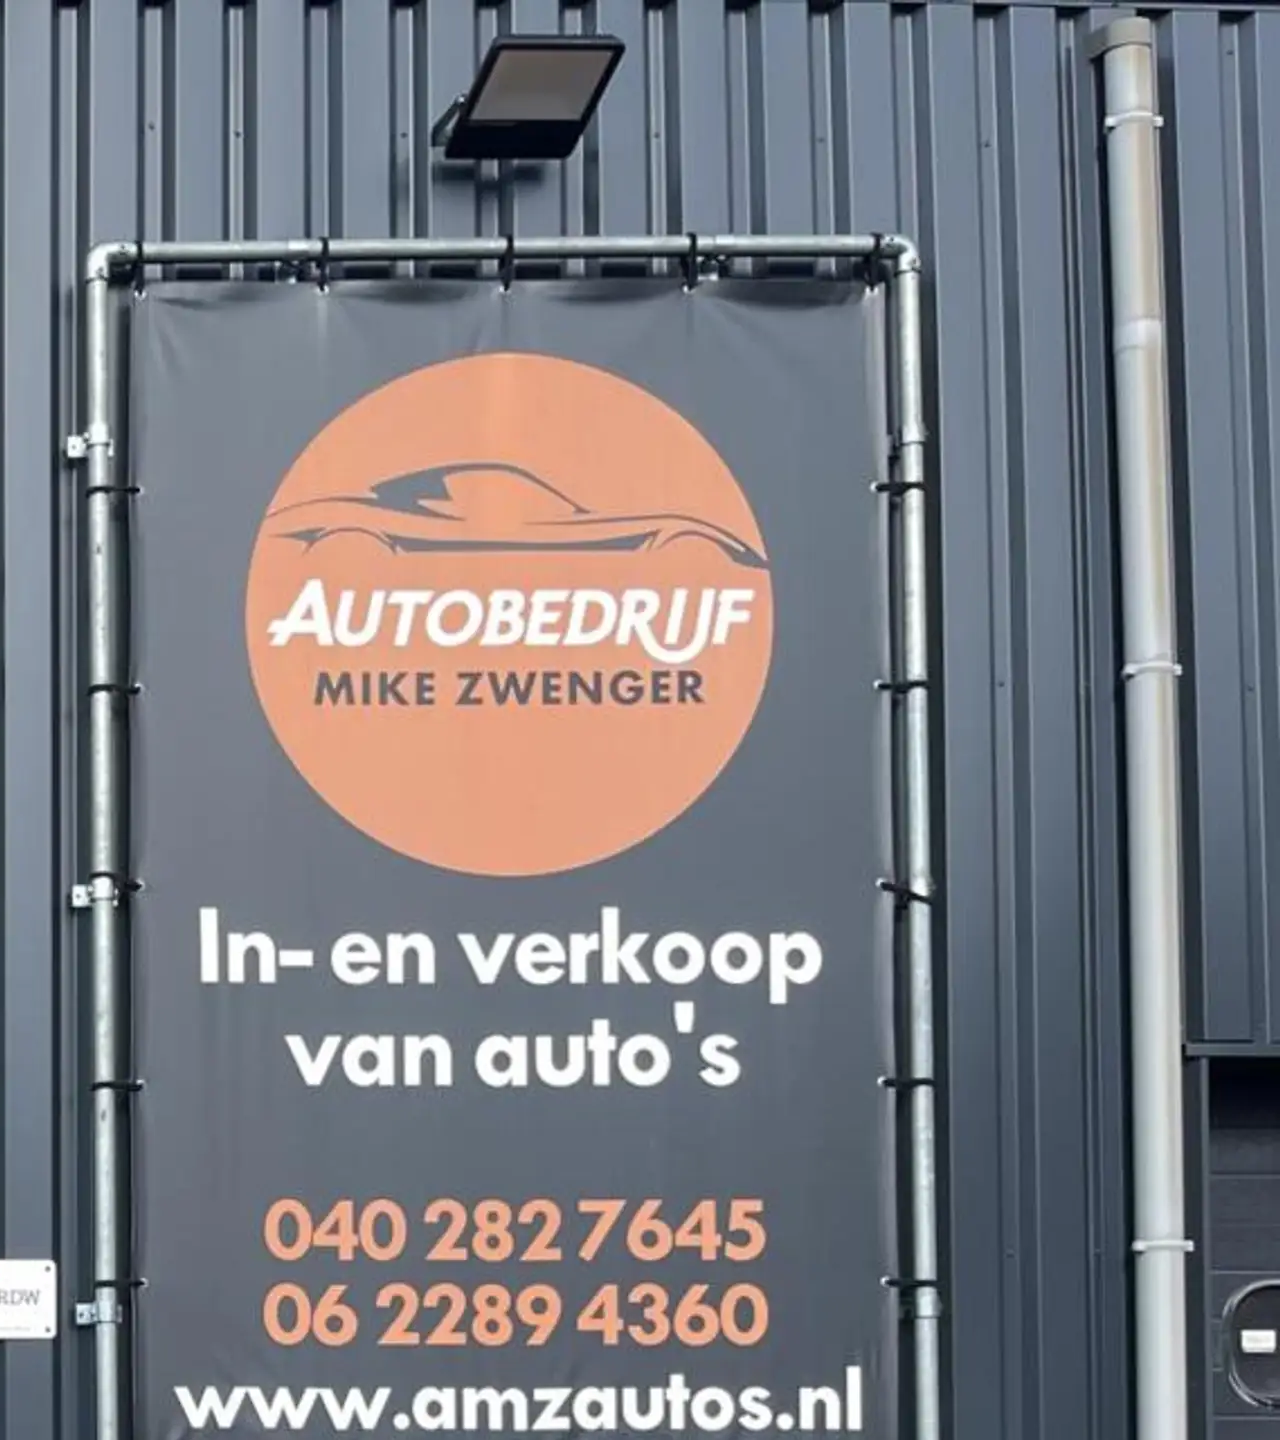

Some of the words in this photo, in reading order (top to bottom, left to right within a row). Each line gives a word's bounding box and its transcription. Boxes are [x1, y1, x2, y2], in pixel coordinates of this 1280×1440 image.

[267, 578, 756, 663] AUTOBEDRIJF
[314, 672, 436, 706] MIKE
[456, 670, 705, 706] ZWENGER
[199, 906, 314, 984] In-
[330, 932, 436, 985] en
[457, 906, 823, 1005] verkoop
[284, 1034, 453, 1087] van
[474, 1000, 741, 1088] auto's
[264, 1197, 407, 1262] 040
[426, 1198, 562, 1262] 282
[576, 1197, 765, 1261] 7645
[263, 1283, 358, 1345] 06
[377, 1283, 561, 1346] 2289
[577, 1282, 769, 1345] 4360
[174, 1365, 862, 1431] www.amzautos.nl
